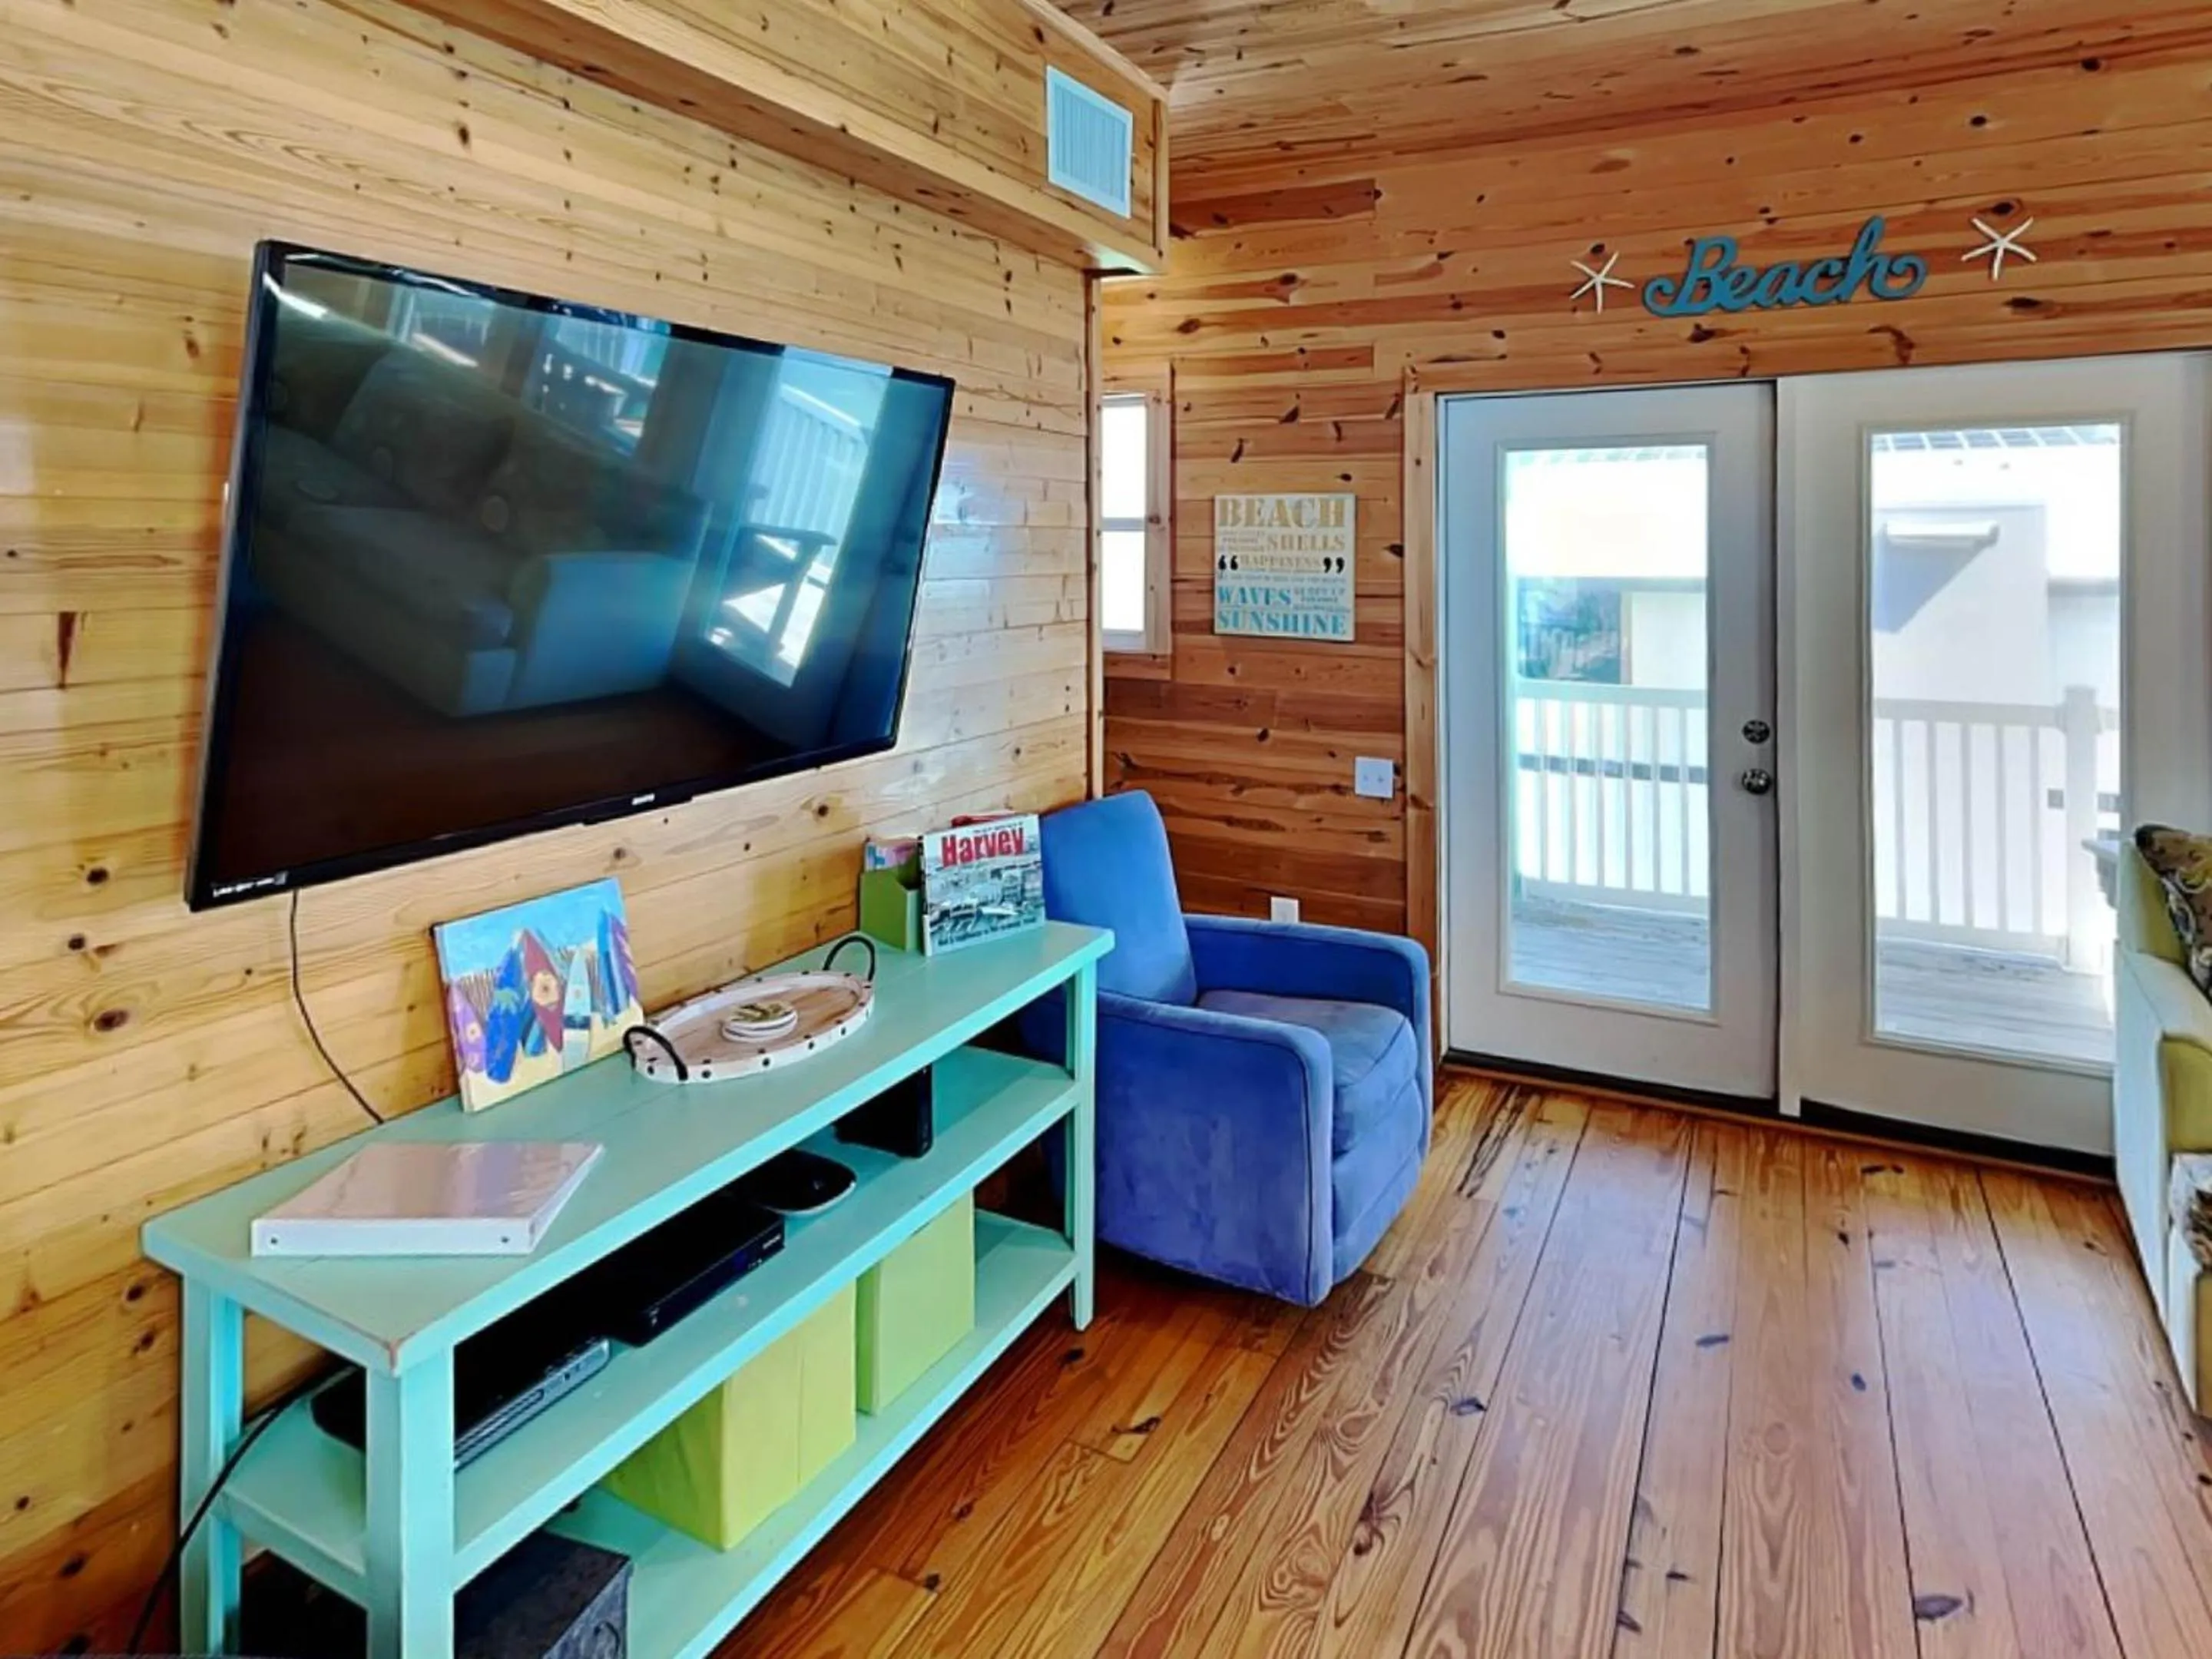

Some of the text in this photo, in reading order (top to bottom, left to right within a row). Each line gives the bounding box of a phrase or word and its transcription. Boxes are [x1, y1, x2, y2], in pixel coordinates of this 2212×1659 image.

[1642, 216, 1927, 317] Beach
[1218, 498, 1345, 528] BEACH
[1267, 533, 1346, 551] SHELLS
[1218, 586, 1291, 605] WAVES
[1218, 610, 1347, 635] SUNSHINE
[940, 826, 1025, 869] Harvey
